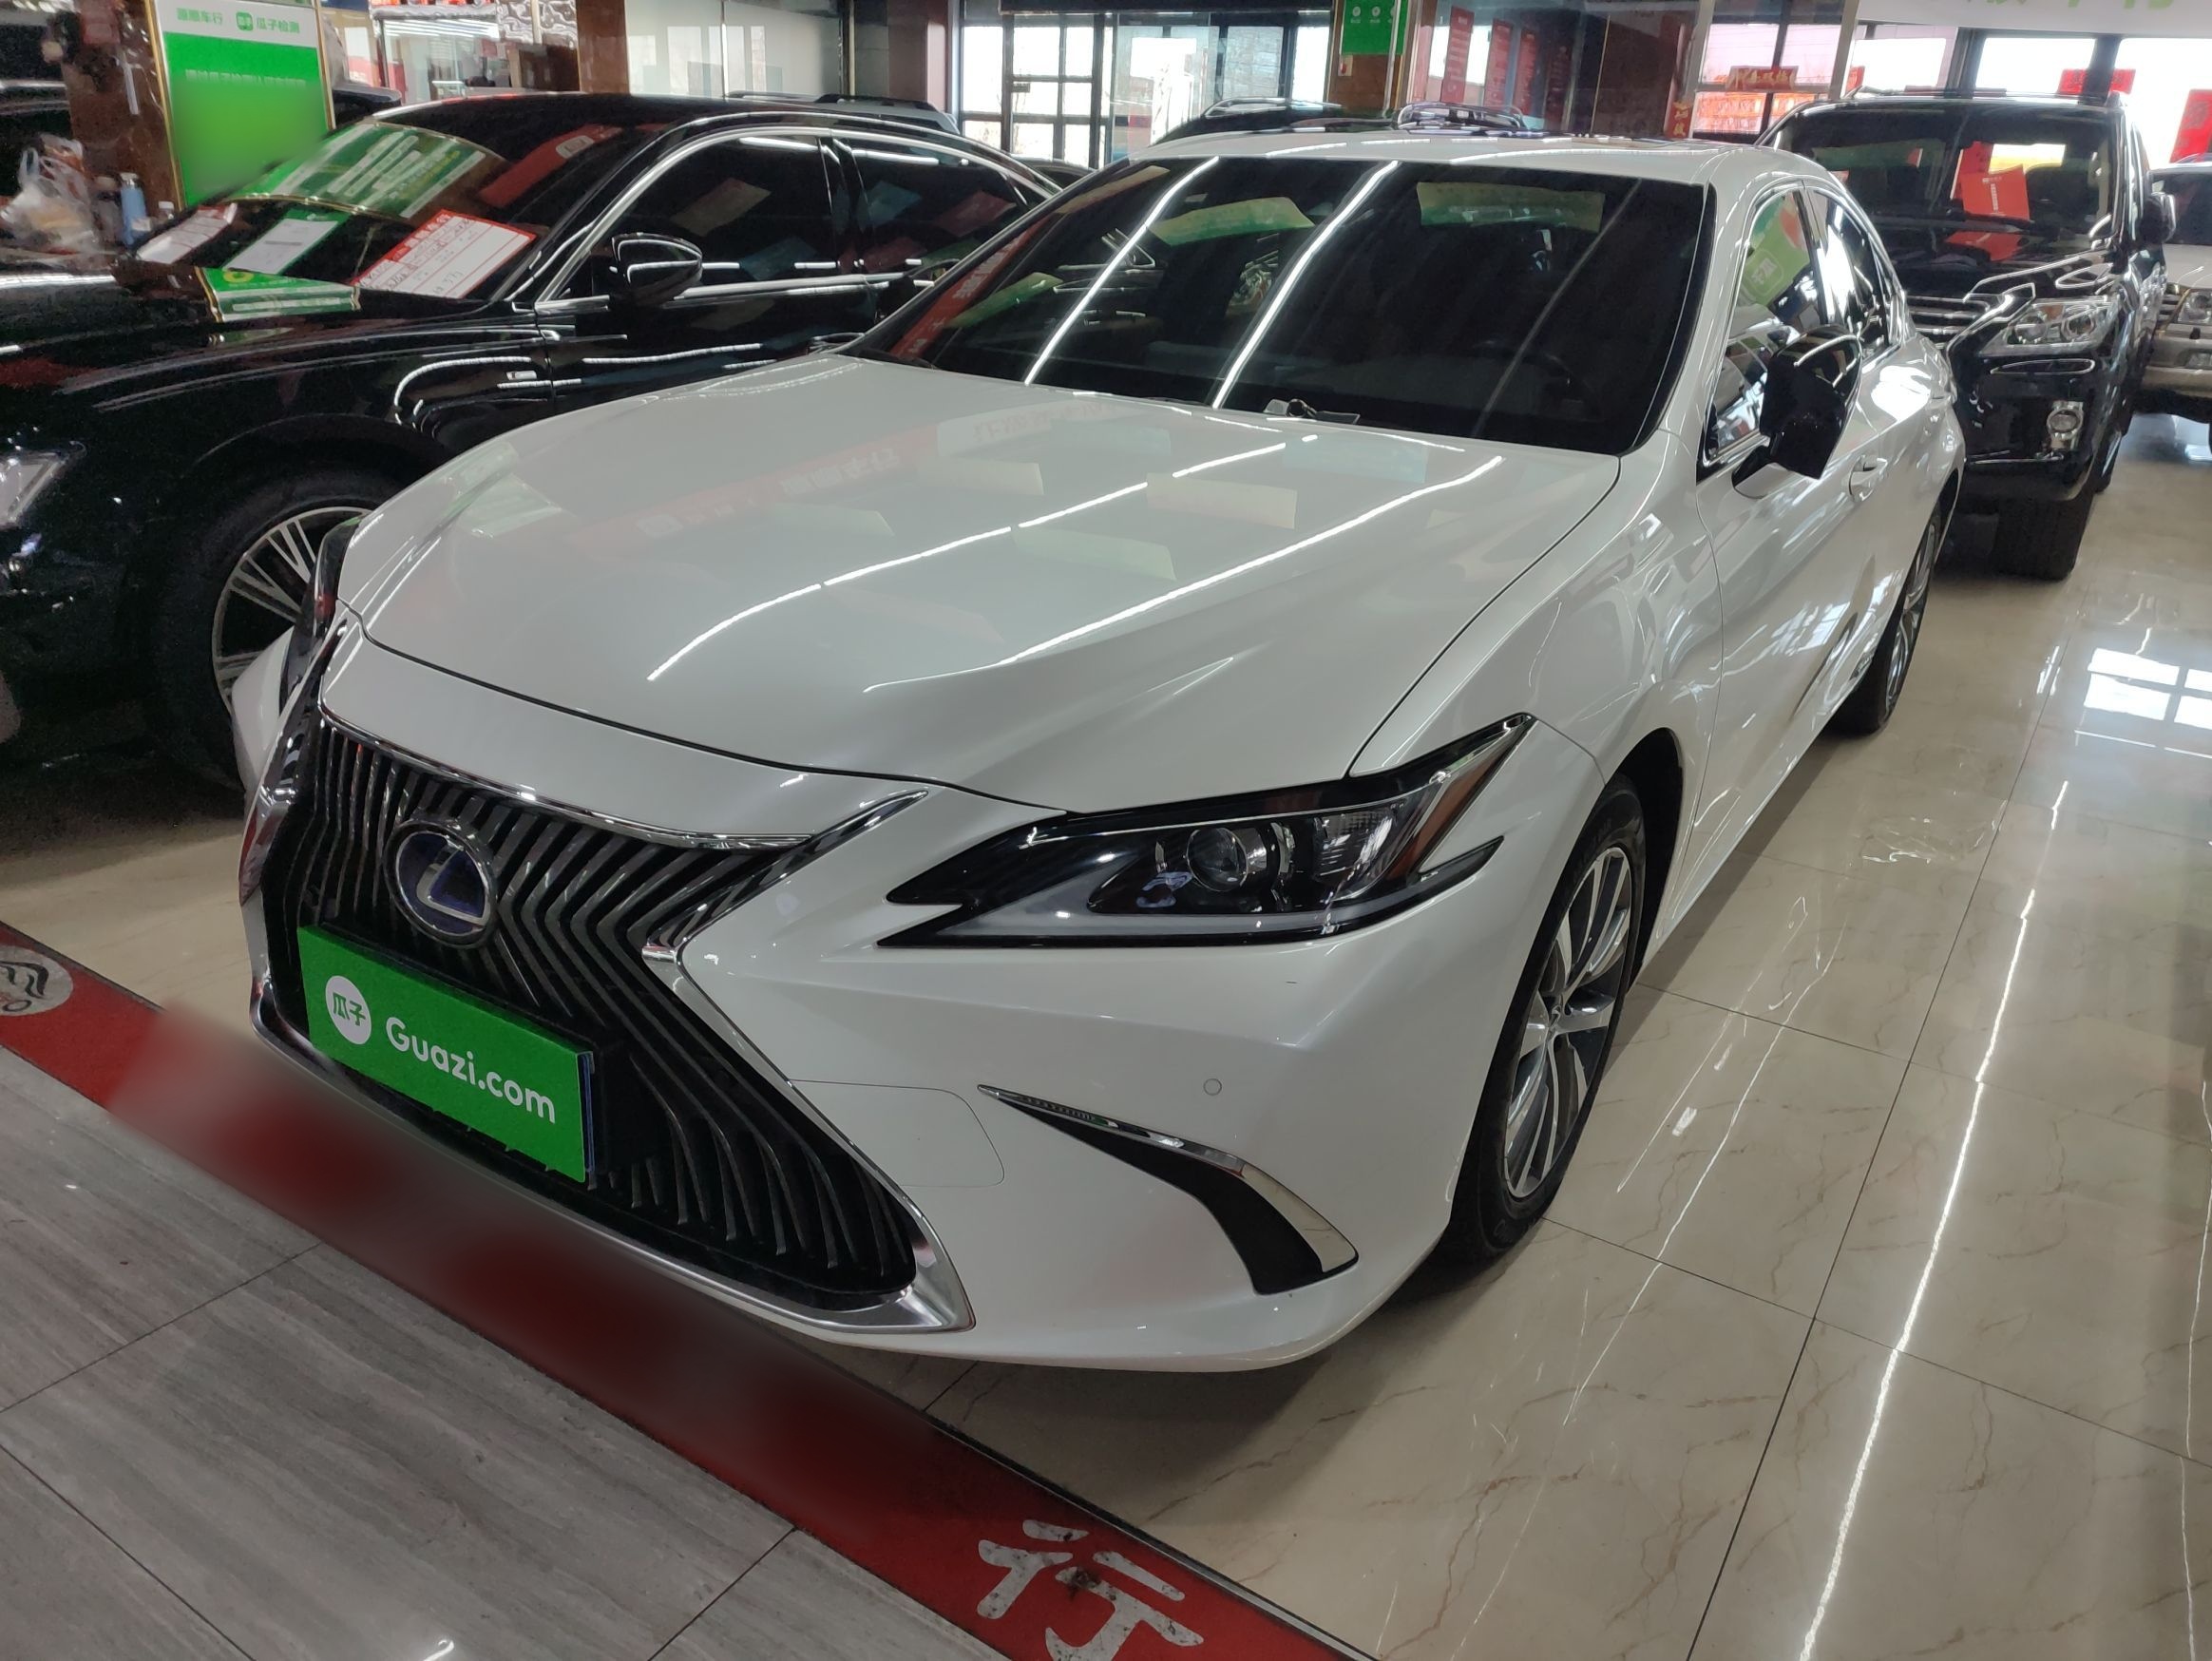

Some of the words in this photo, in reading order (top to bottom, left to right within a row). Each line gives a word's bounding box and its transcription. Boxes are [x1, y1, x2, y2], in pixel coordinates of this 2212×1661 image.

[332, 992, 366, 1026] 瓜子
[386, 1016, 556, 1124] Guazi.com
[977, 1519, 1205, 1661] 行
